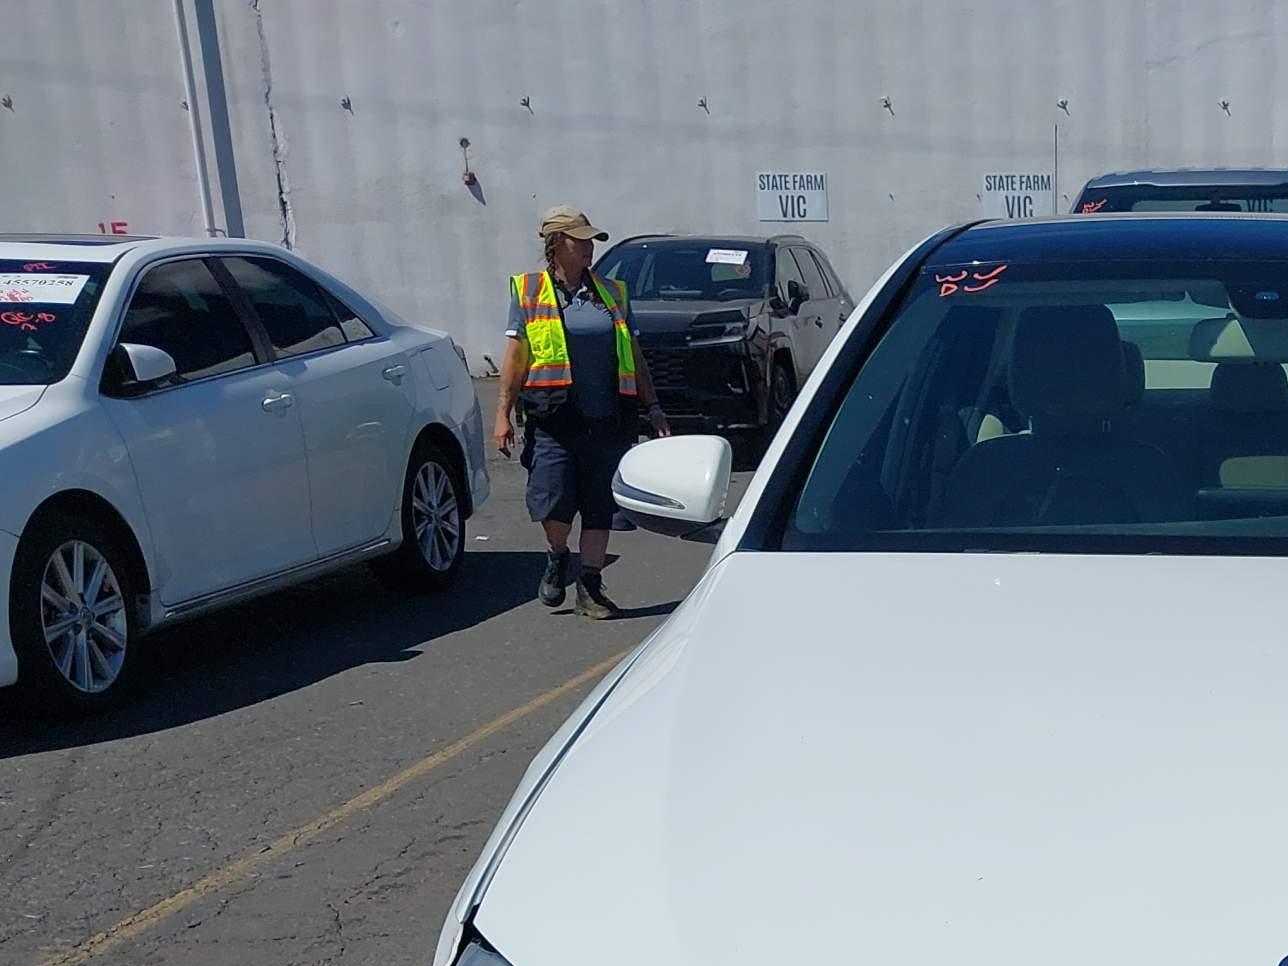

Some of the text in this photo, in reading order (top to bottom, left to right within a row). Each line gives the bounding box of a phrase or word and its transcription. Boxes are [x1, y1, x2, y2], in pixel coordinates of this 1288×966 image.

[759, 174, 824, 190] STATE FARM
[985, 175, 1051, 191] STATE FARM
[778, 195, 807, 218] VIC
[1005, 196, 1033, 218] VIC
